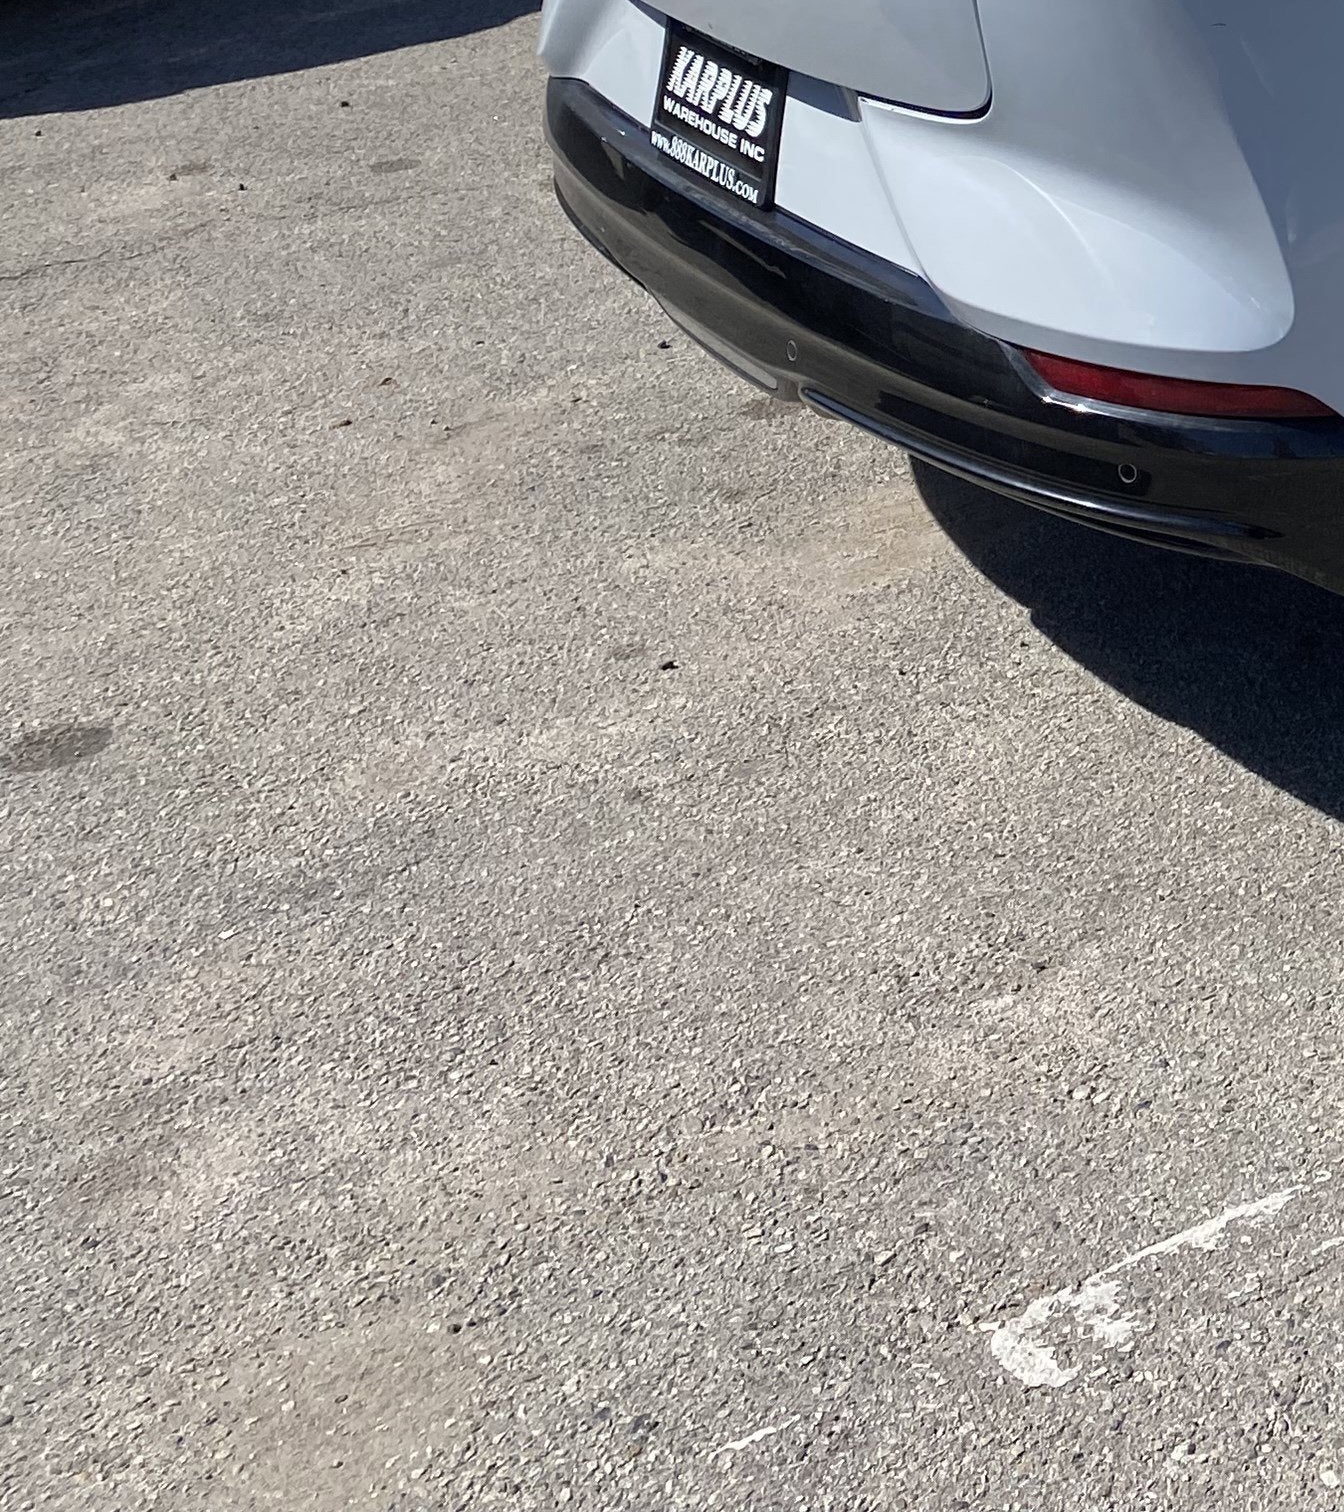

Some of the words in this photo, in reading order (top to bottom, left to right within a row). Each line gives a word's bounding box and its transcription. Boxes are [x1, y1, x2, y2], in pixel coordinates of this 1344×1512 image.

[663, 95, 737, 149] WAREHOUSE
[741, 137, 765, 162] INC
[666, 46, 773, 138] KARPLUS
